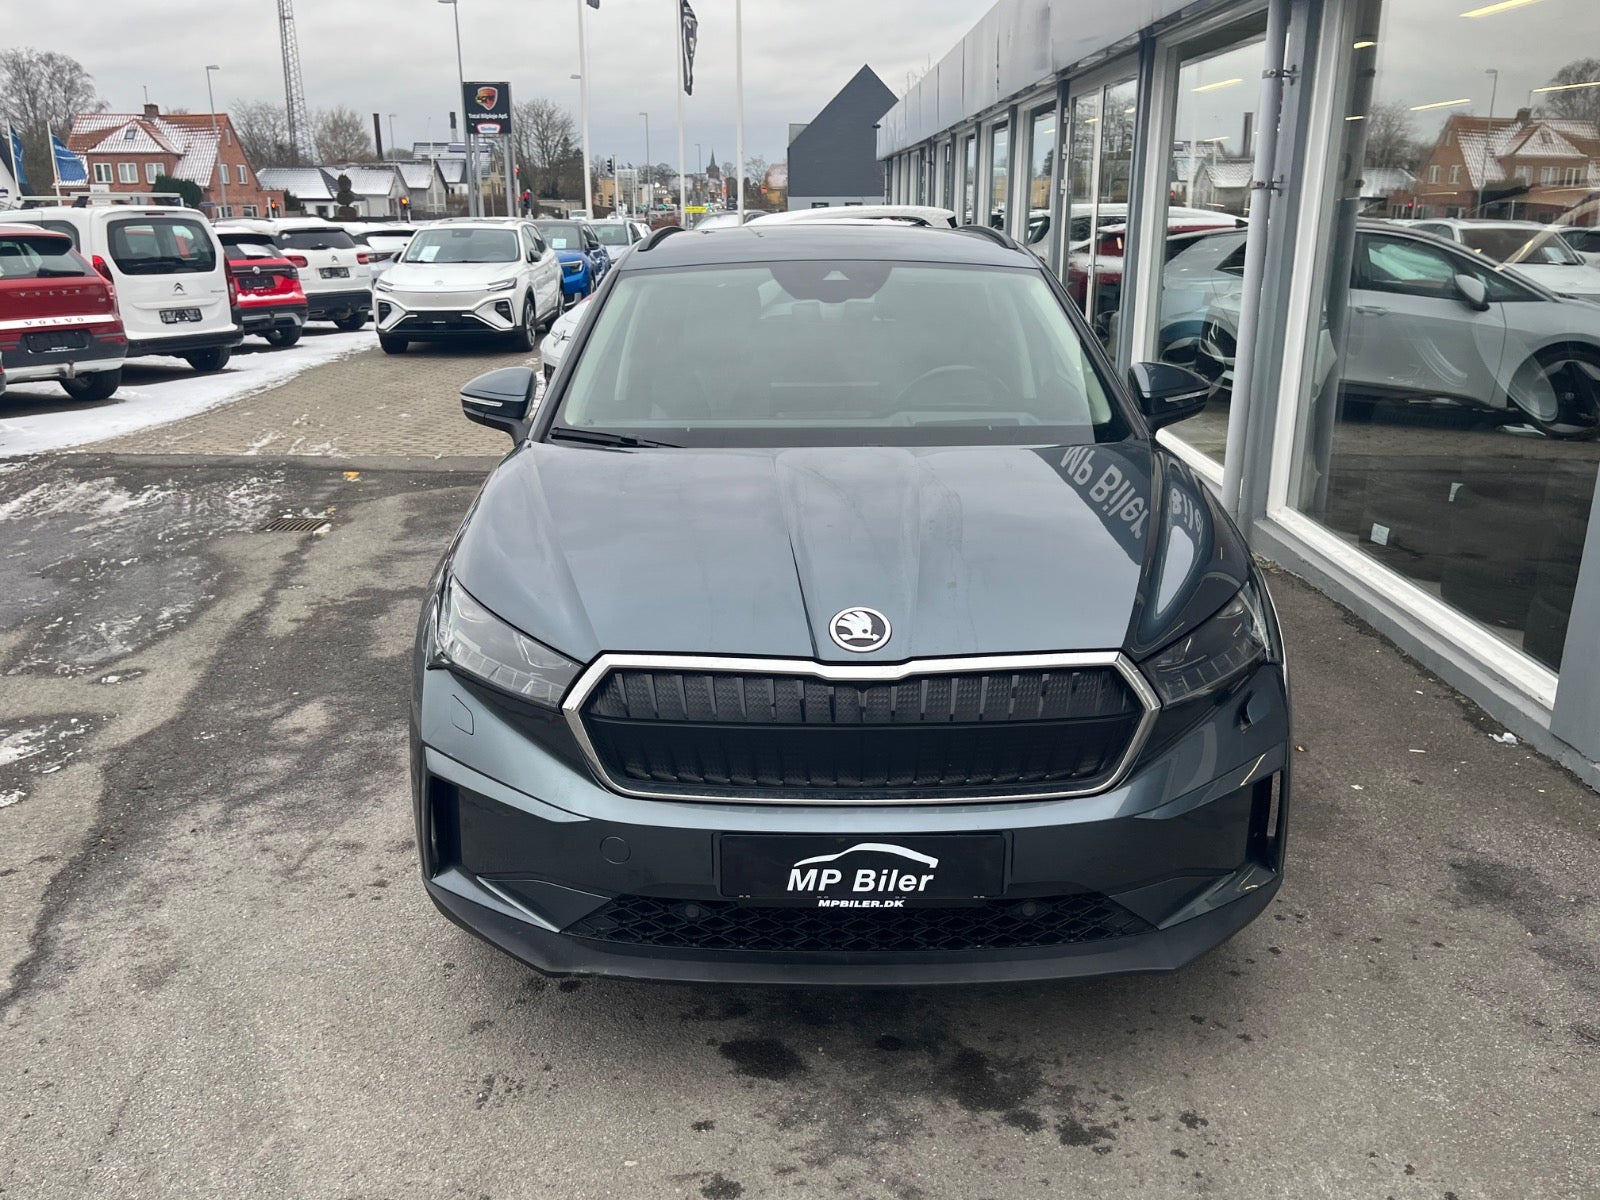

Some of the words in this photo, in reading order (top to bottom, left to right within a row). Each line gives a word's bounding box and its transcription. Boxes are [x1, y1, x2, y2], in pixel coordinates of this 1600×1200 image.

[24, 317, 85, 326] VOLVO
[786, 868, 842, 892] MP
[852, 868, 934, 892] Biler
[817, 899, 905, 908] MPBILER.DK
